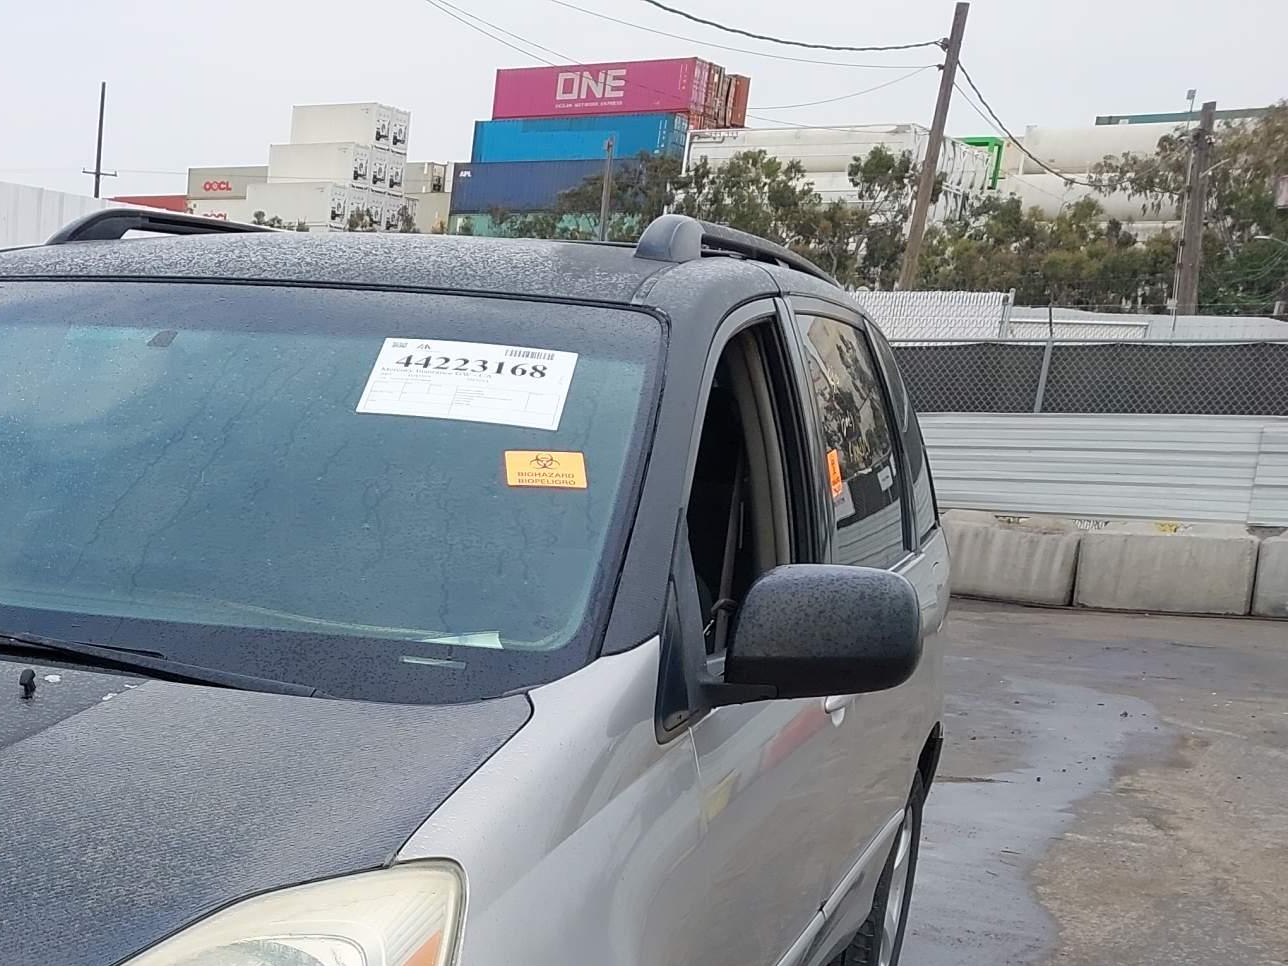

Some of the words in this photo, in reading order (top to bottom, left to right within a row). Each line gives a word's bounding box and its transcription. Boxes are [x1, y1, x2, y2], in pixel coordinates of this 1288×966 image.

[556, 69, 627, 100] ONE
[203, 181, 232, 191] OOCL
[395, 354, 548, 378] 44223168
[517, 471, 575, 479] BIOHAZARD
[518, 478, 576, 486] BIOPELIGRO
